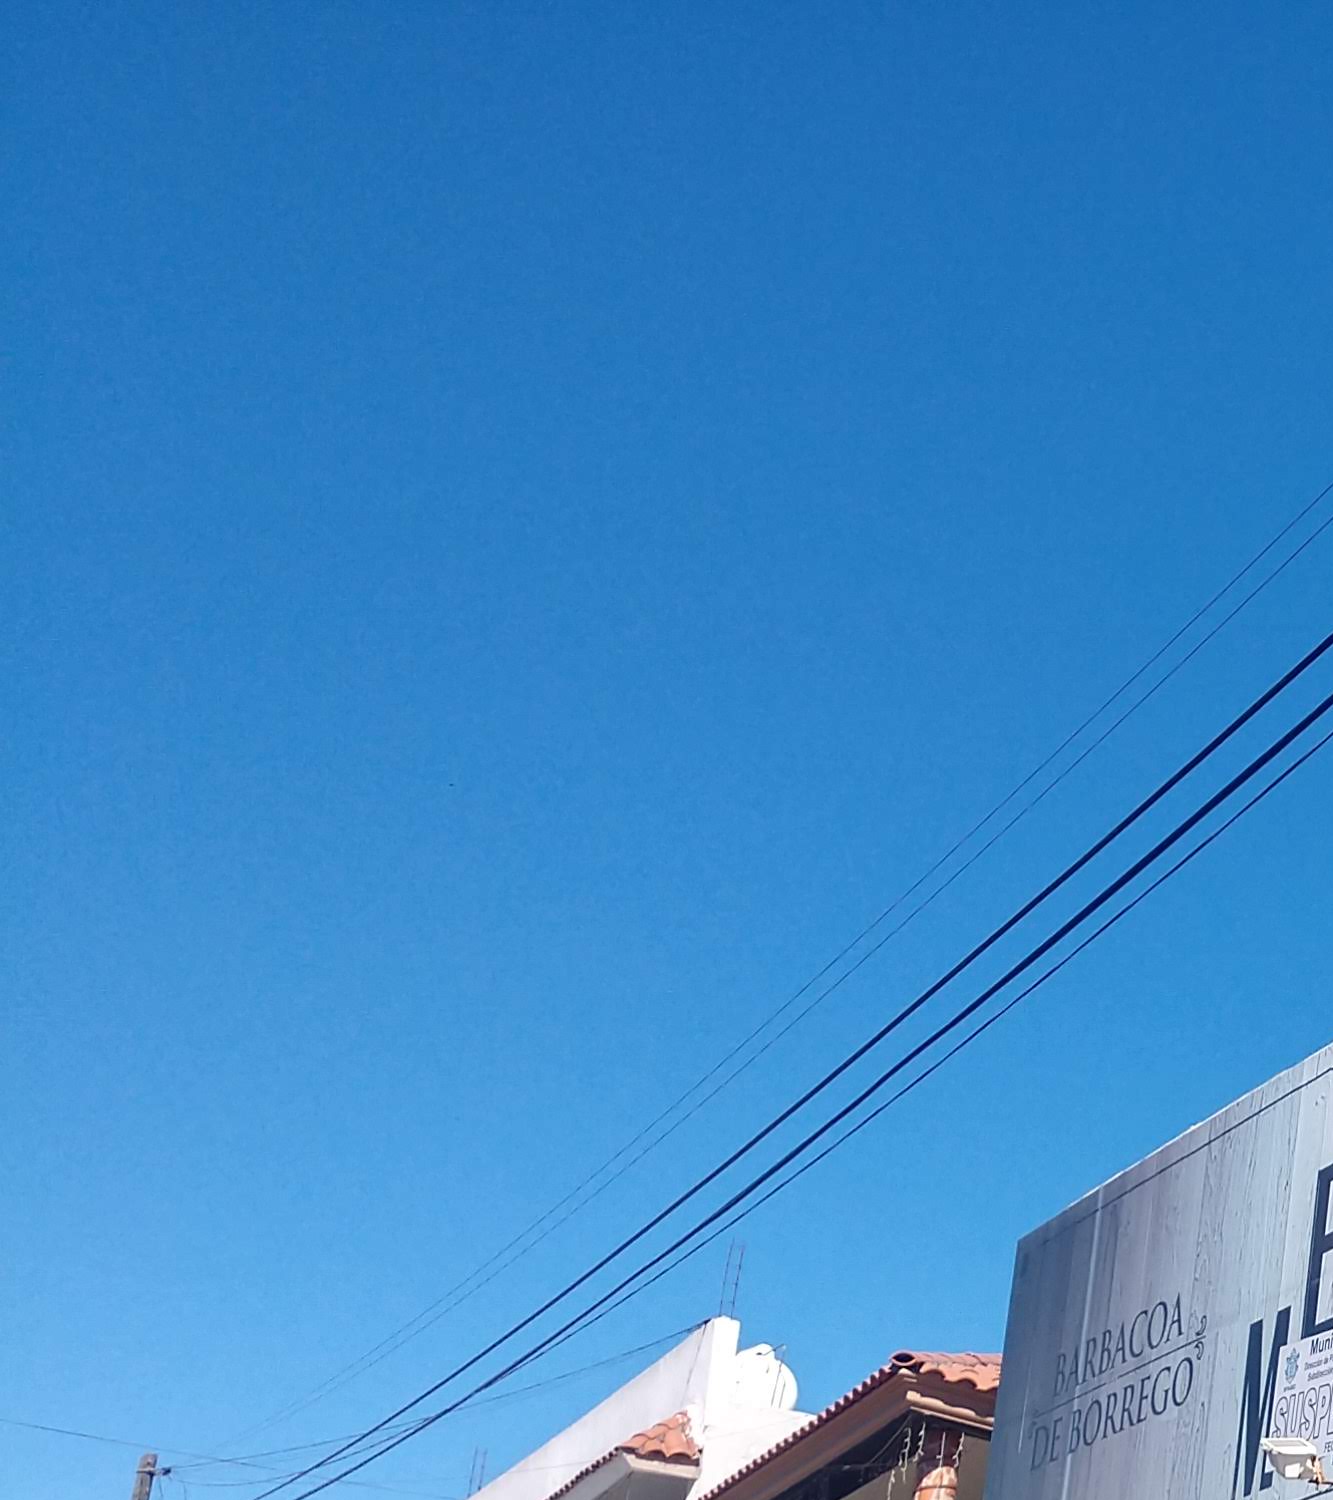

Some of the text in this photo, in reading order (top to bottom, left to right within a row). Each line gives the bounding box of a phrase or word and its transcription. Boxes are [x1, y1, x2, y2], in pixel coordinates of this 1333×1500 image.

[1053, 1291, 1185, 1398] BARBACOA
[1030, 1356, 1194, 1472] DE BORREGO
